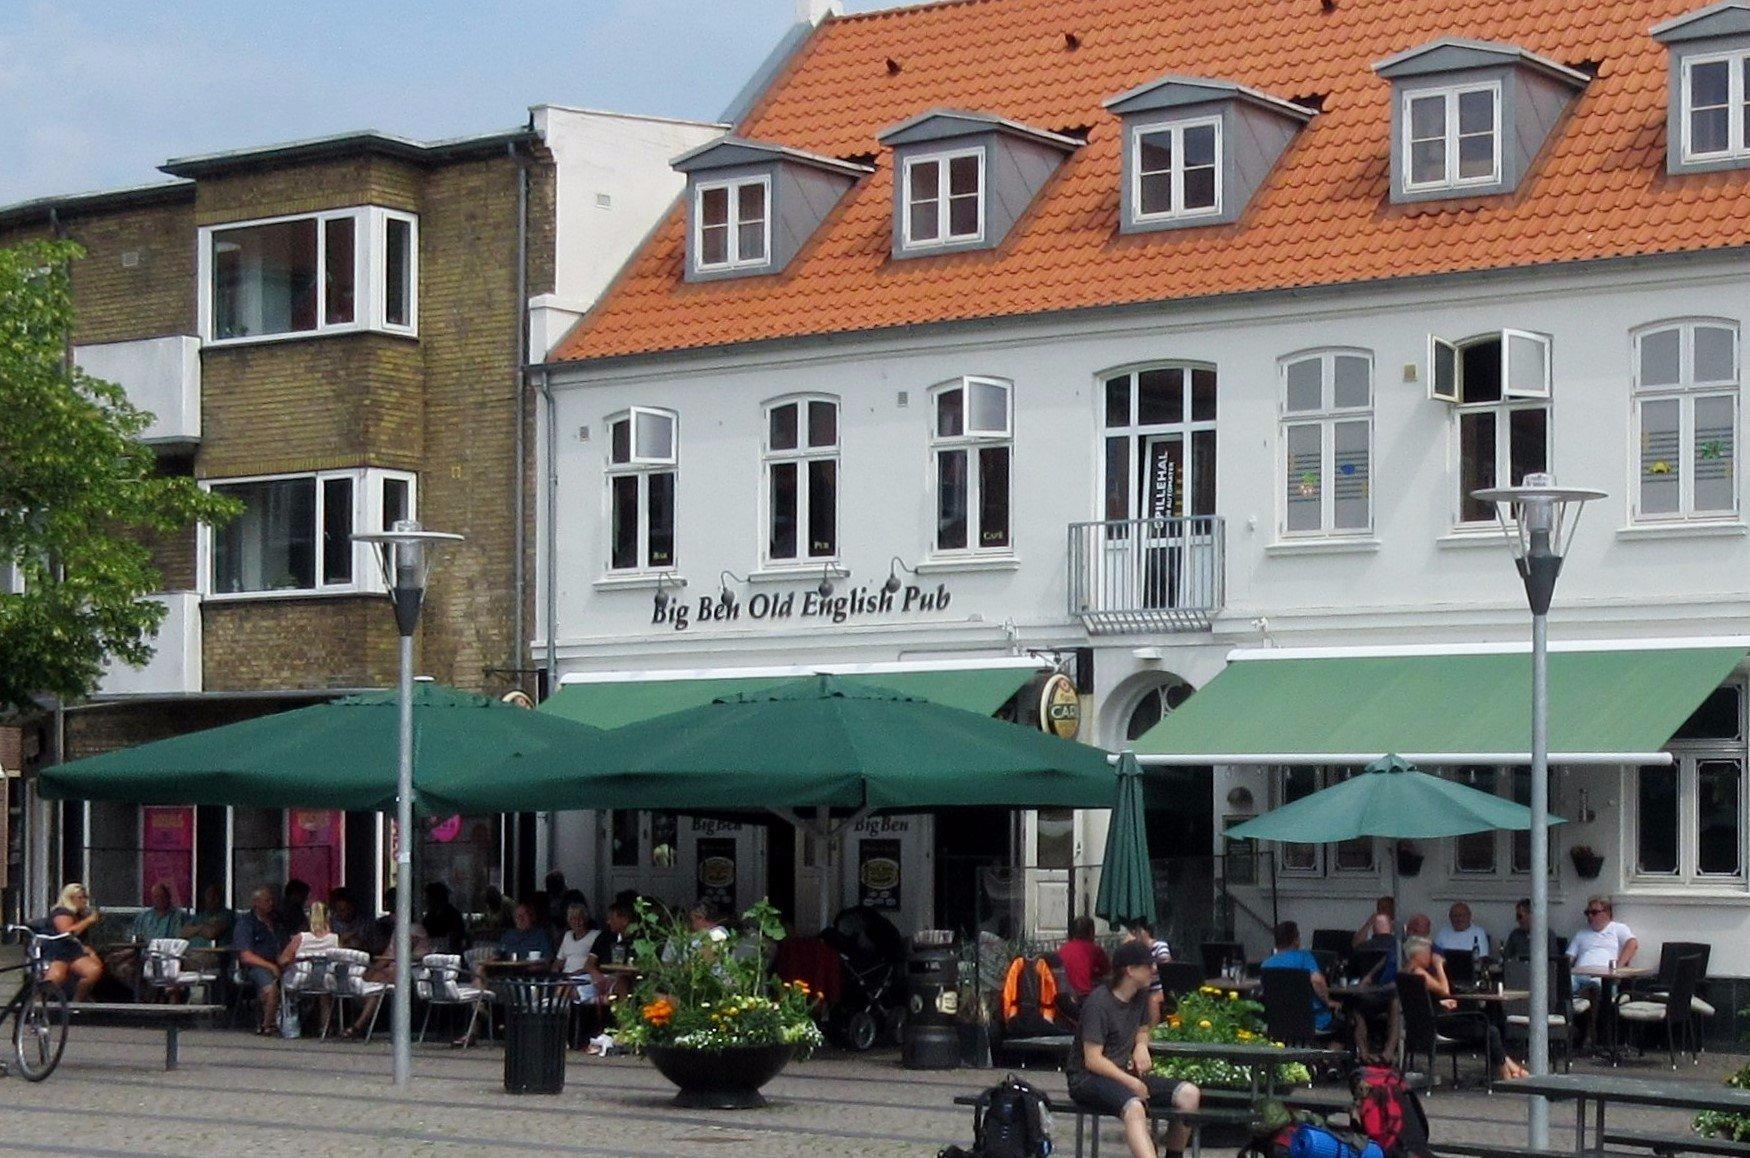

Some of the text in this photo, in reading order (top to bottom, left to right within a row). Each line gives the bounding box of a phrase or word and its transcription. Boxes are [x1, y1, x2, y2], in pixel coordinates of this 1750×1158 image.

[1153, 450, 1169, 529] SPILLEHAL
[651, 583, 952, 631] Big Ben Old English Pub
